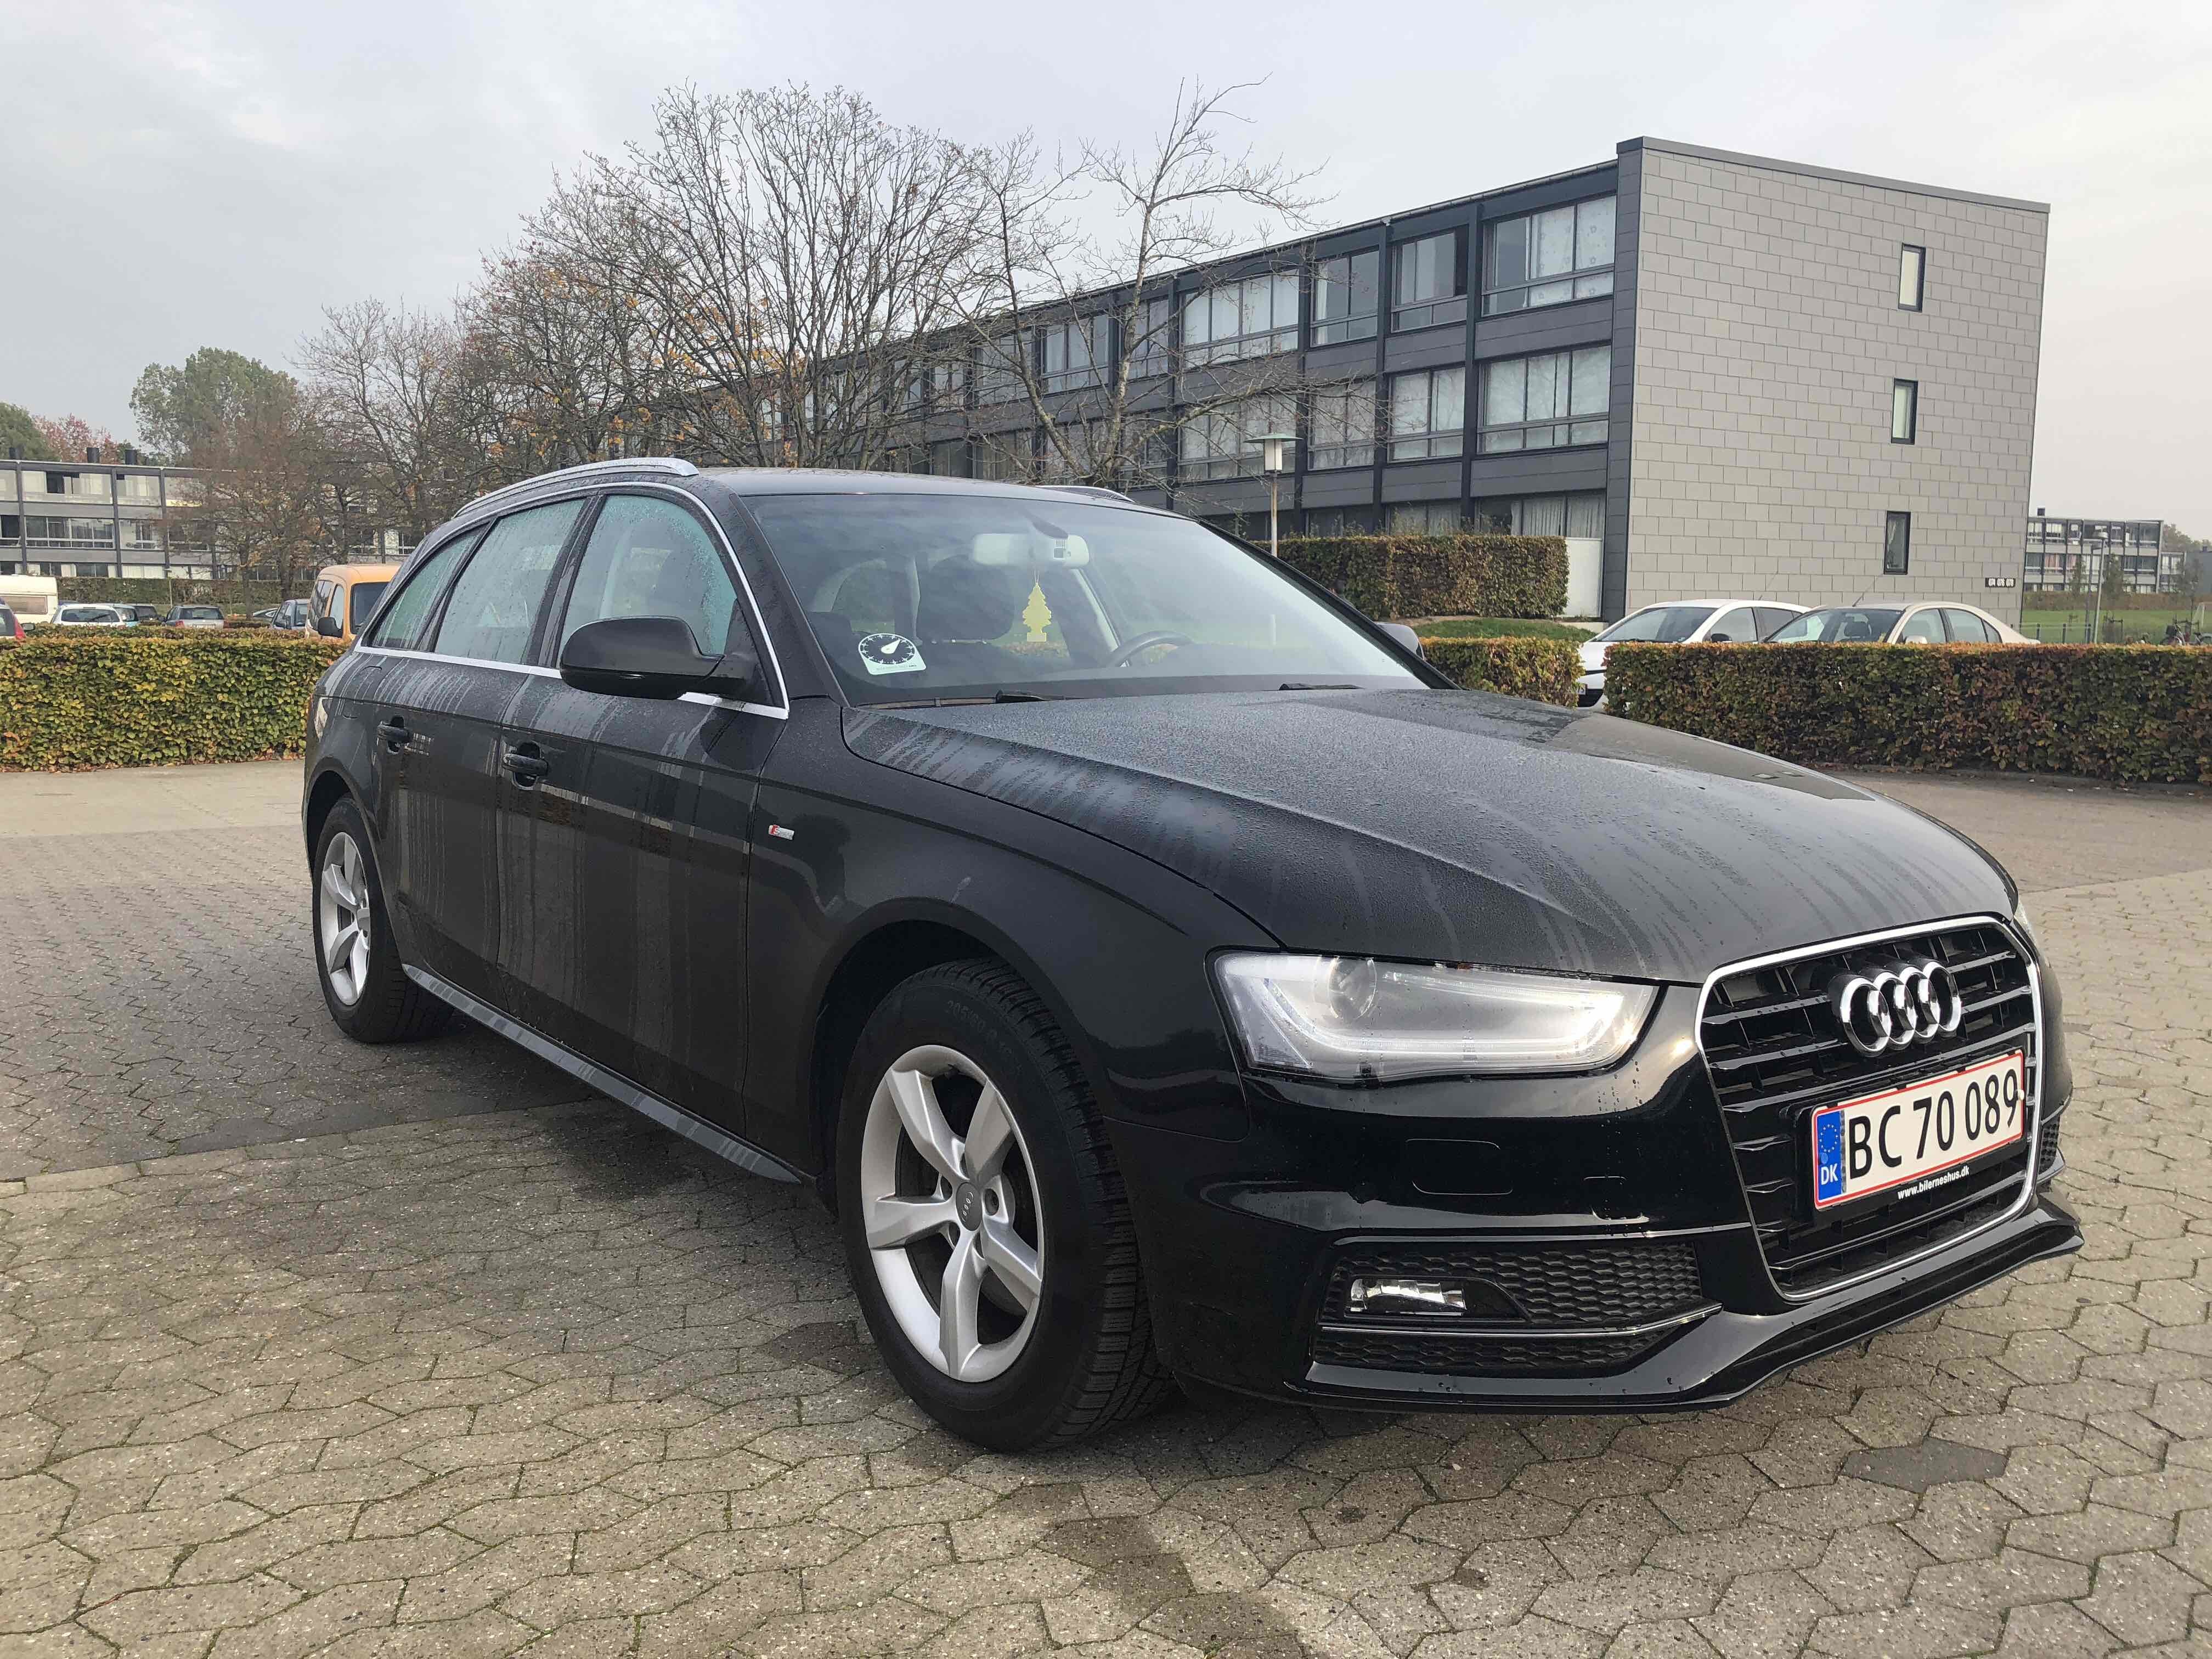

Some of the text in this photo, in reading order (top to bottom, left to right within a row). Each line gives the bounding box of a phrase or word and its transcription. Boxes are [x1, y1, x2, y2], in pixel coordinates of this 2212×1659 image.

[1849, 1069, 2018, 1180] BC 70 089
[1821, 1164, 1838, 1185] DK
[1898, 1165, 1970, 1199] www.bilerneshus.dk
